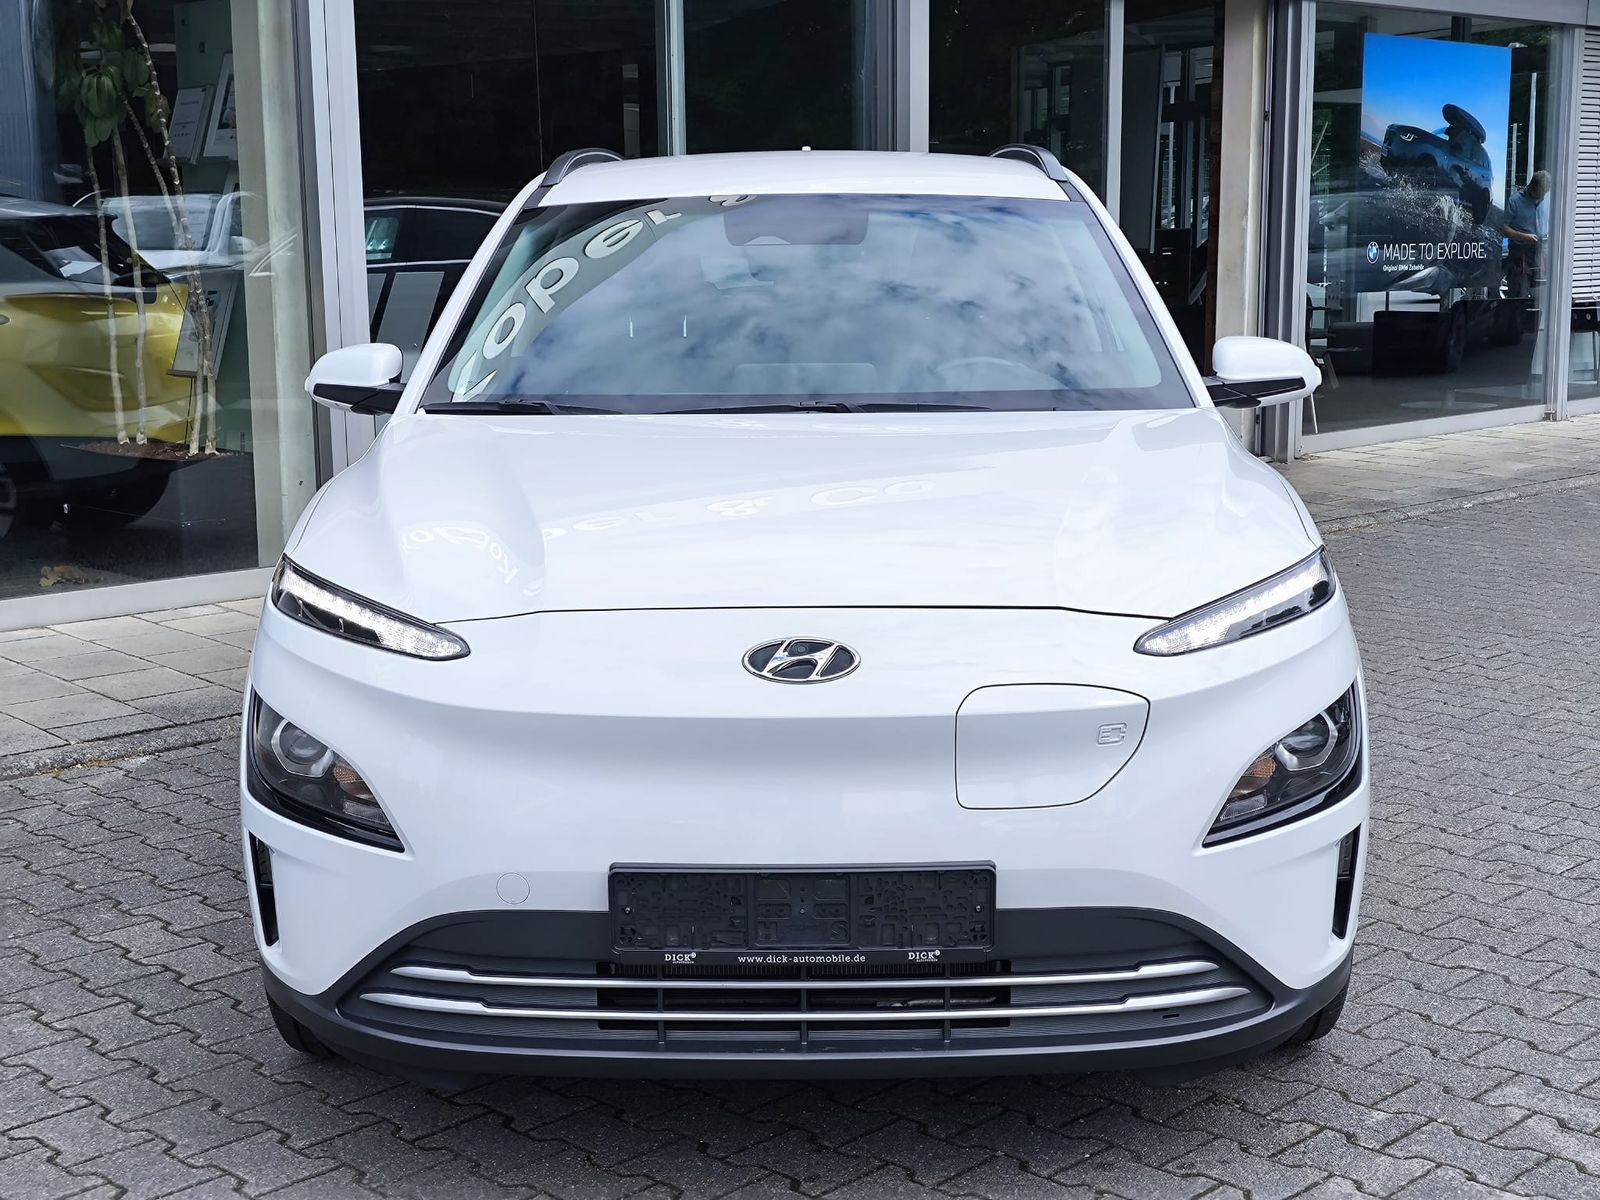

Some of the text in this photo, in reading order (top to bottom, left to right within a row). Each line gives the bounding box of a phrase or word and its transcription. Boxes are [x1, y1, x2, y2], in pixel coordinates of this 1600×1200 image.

[1383, 241, 1487, 260] MADE TO EXPLORE.
[738, 954, 866, 963] www.dick-automobile.de
